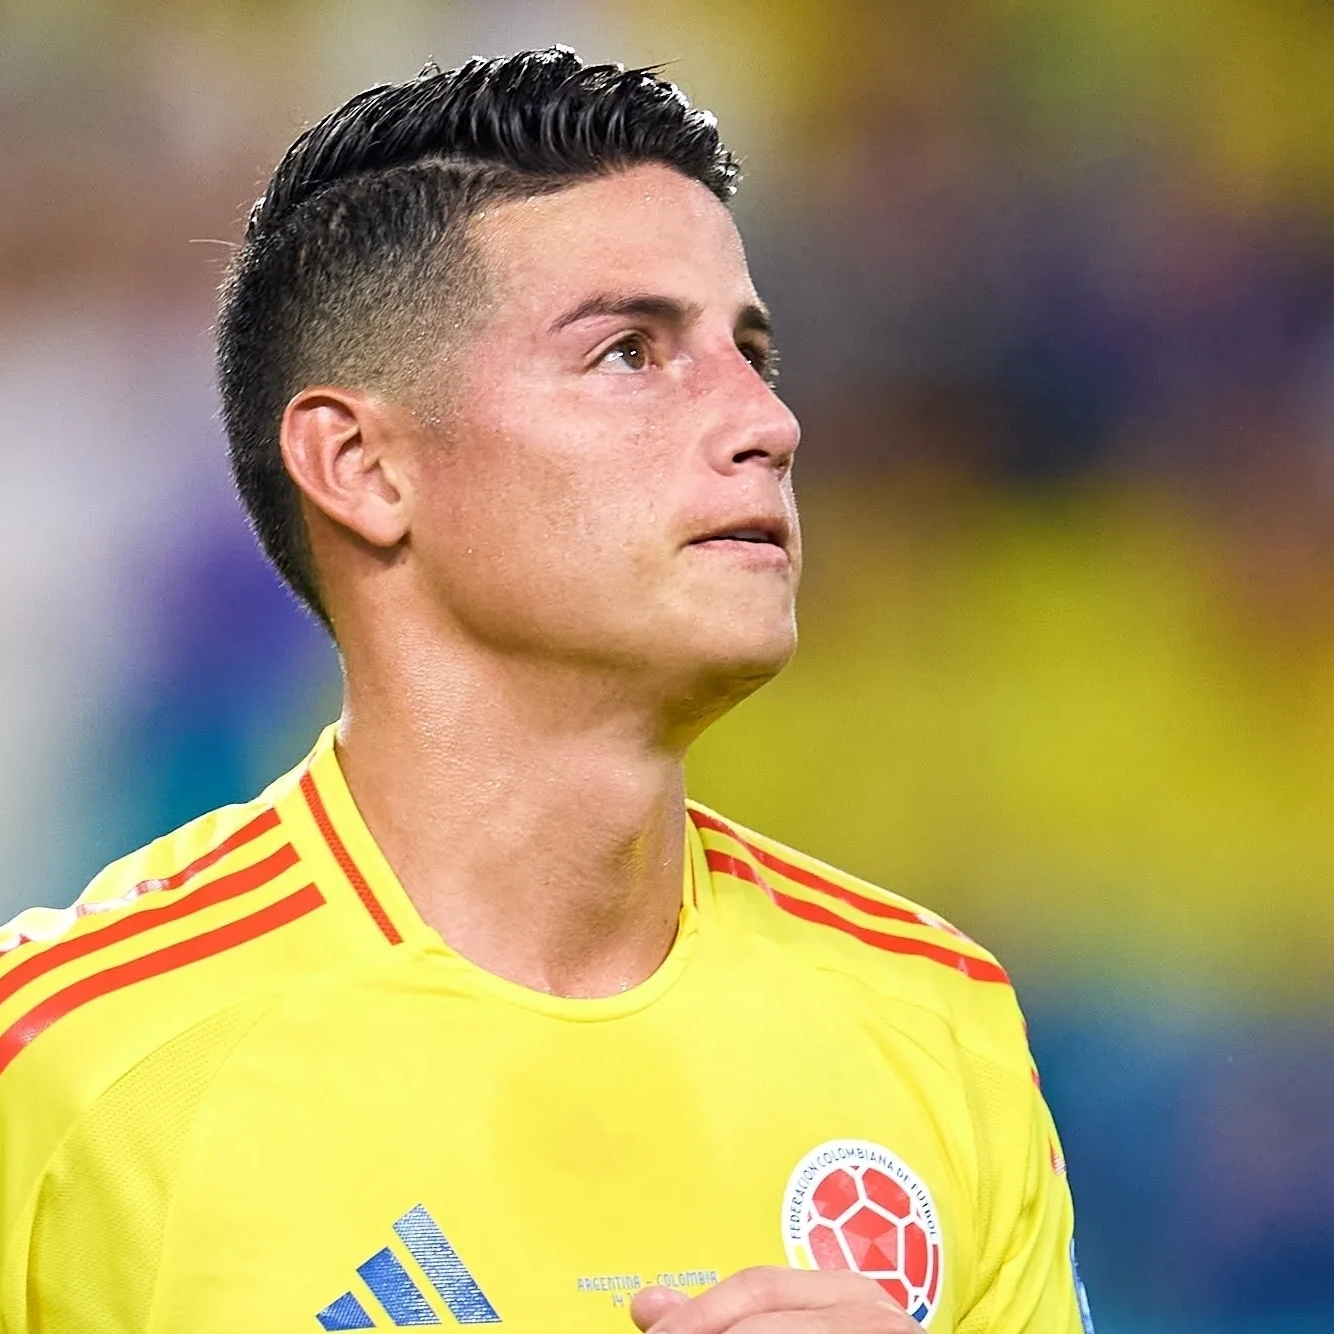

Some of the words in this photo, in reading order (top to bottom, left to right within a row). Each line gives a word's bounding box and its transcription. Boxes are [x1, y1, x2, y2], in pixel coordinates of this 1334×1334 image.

[818, 1146, 894, 1171] COLOMBIANA
[895, 1169, 909, 1186] DE
[910, 1183, 938, 1236] FUTBOL
[577, 1275, 641, 1292] ARGENTINA
[656, 1270, 718, 1288] COLOMBIA
